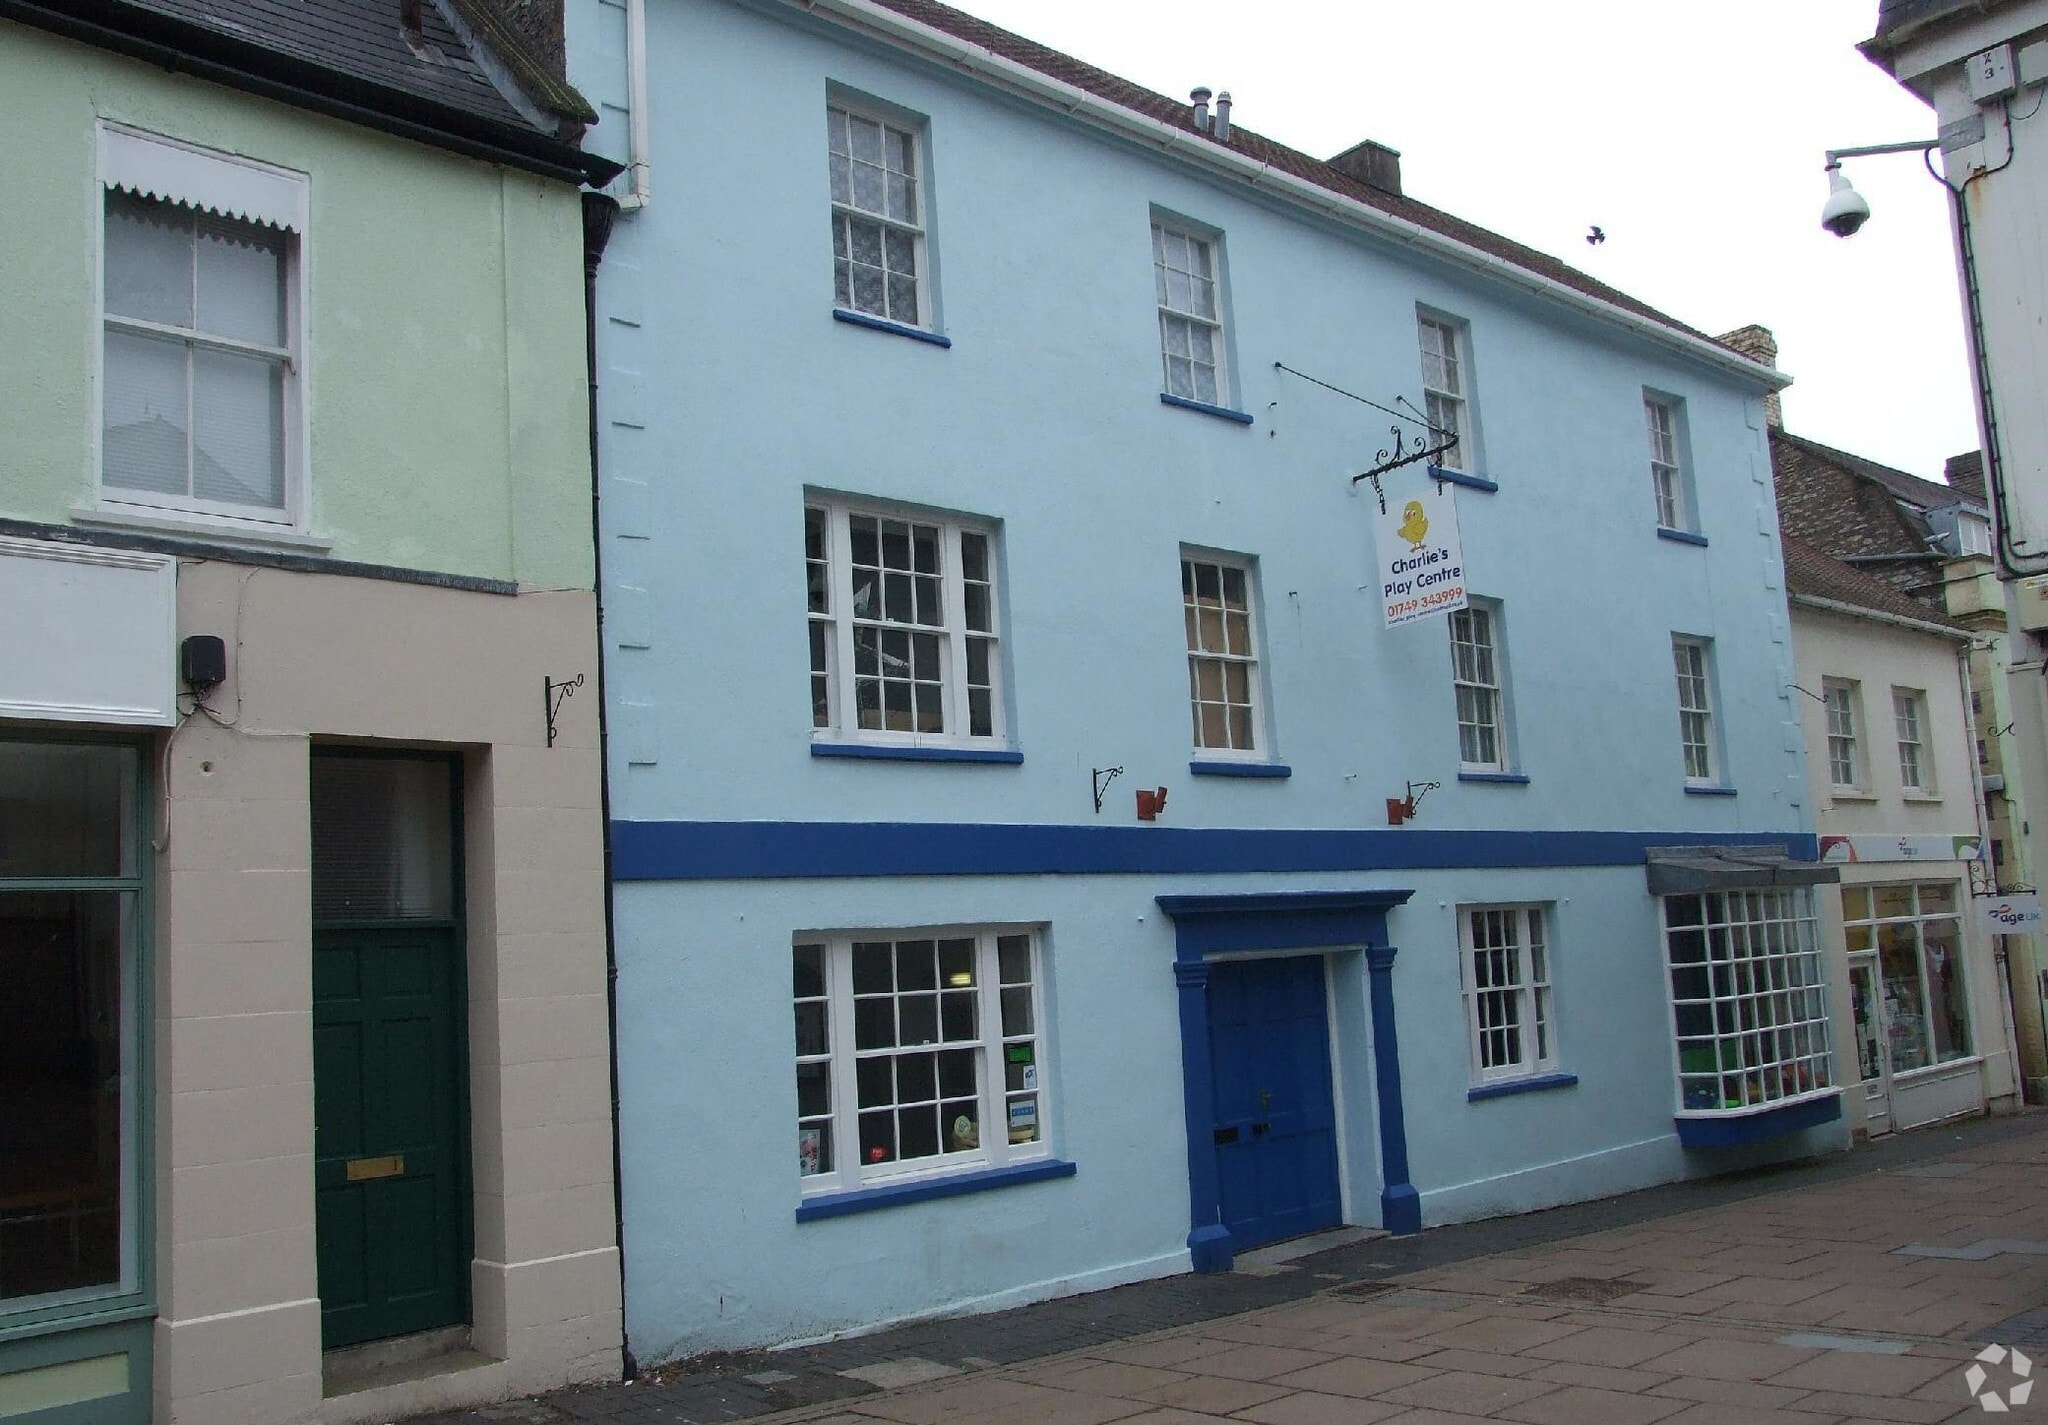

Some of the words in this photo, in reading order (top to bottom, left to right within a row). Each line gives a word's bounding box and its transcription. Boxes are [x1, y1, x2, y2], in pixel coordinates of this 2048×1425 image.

[1391, 547, 1449, 574] Charlie's
[1384, 580, 1412, 598] Play
[1416, 567, 1461, 588] Centre
[1387, 599, 1418, 617] 01749
[1421, 587, 1462, 607] 343999
[2000, 913, 2025, 926] age
